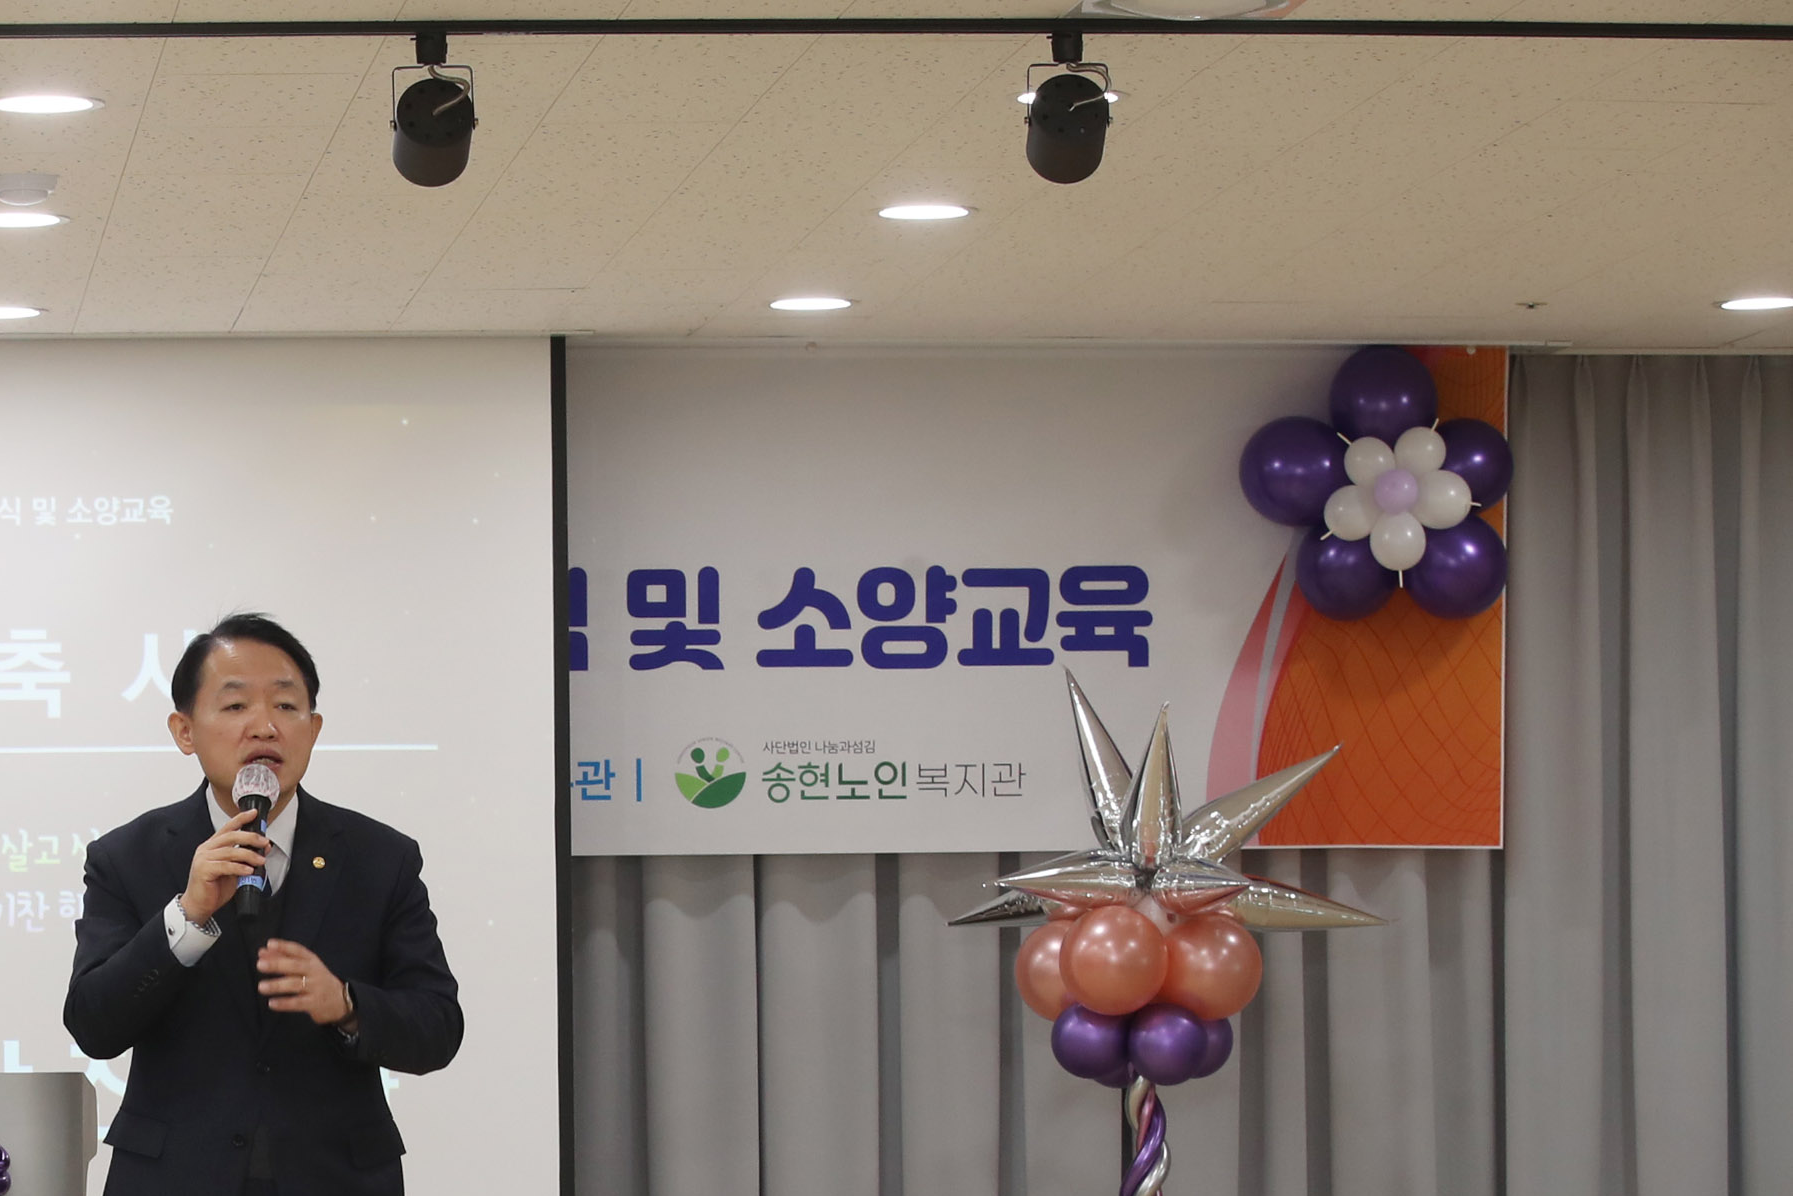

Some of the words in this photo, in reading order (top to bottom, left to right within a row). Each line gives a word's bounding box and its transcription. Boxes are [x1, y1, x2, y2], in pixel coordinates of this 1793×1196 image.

[31, 496, 57, 526] 및
[66, 495, 174, 526] 소양교육
[626, 565, 725, 671] 및
[756, 564, 1153, 669] 소양교육
[762, 740, 811, 754] 사단법인
[814, 740, 876, 754] 나눔과섬김
[570, 759, 616, 801] 관
[1, 828, 61, 873] 살고
